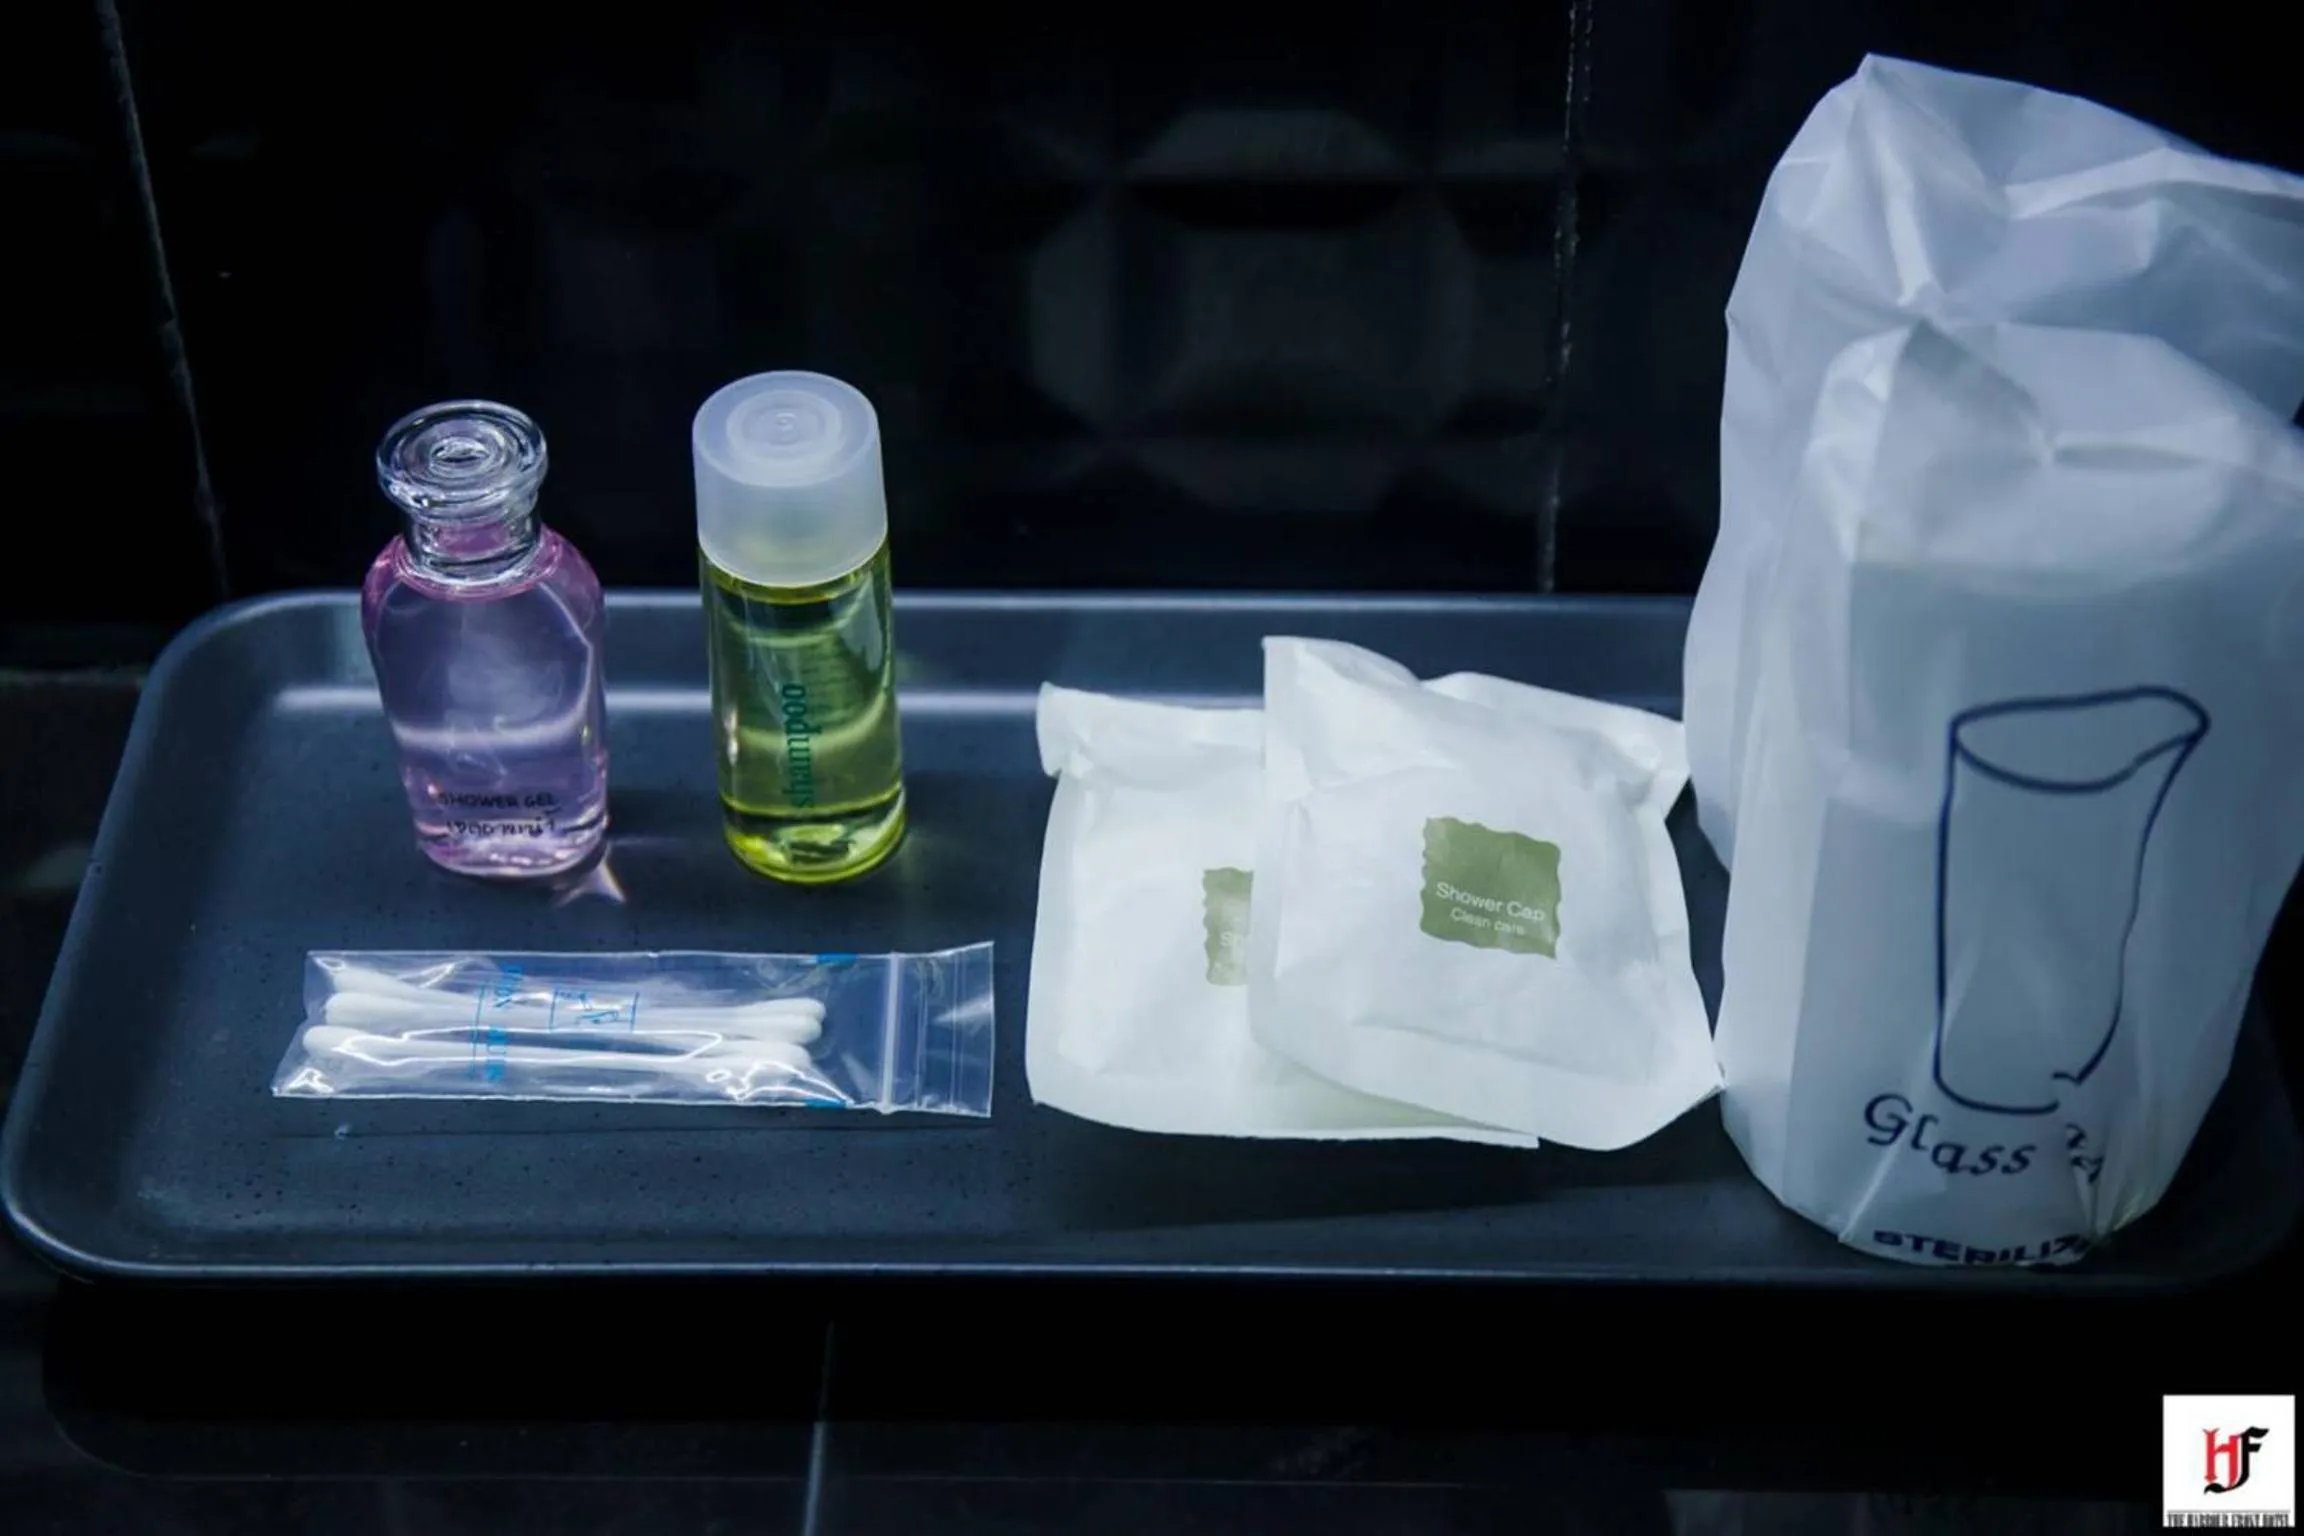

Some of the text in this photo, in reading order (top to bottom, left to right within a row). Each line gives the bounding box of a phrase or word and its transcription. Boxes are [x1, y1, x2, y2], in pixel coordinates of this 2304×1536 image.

[782, 683, 822, 809] shampoo
[438, 790, 558, 810] SHOWER GEL
[1435, 880, 1546, 923] Shower Cap
[1449, 906, 1492, 929] Clean
[1864, 1094, 2036, 1176] Glass
